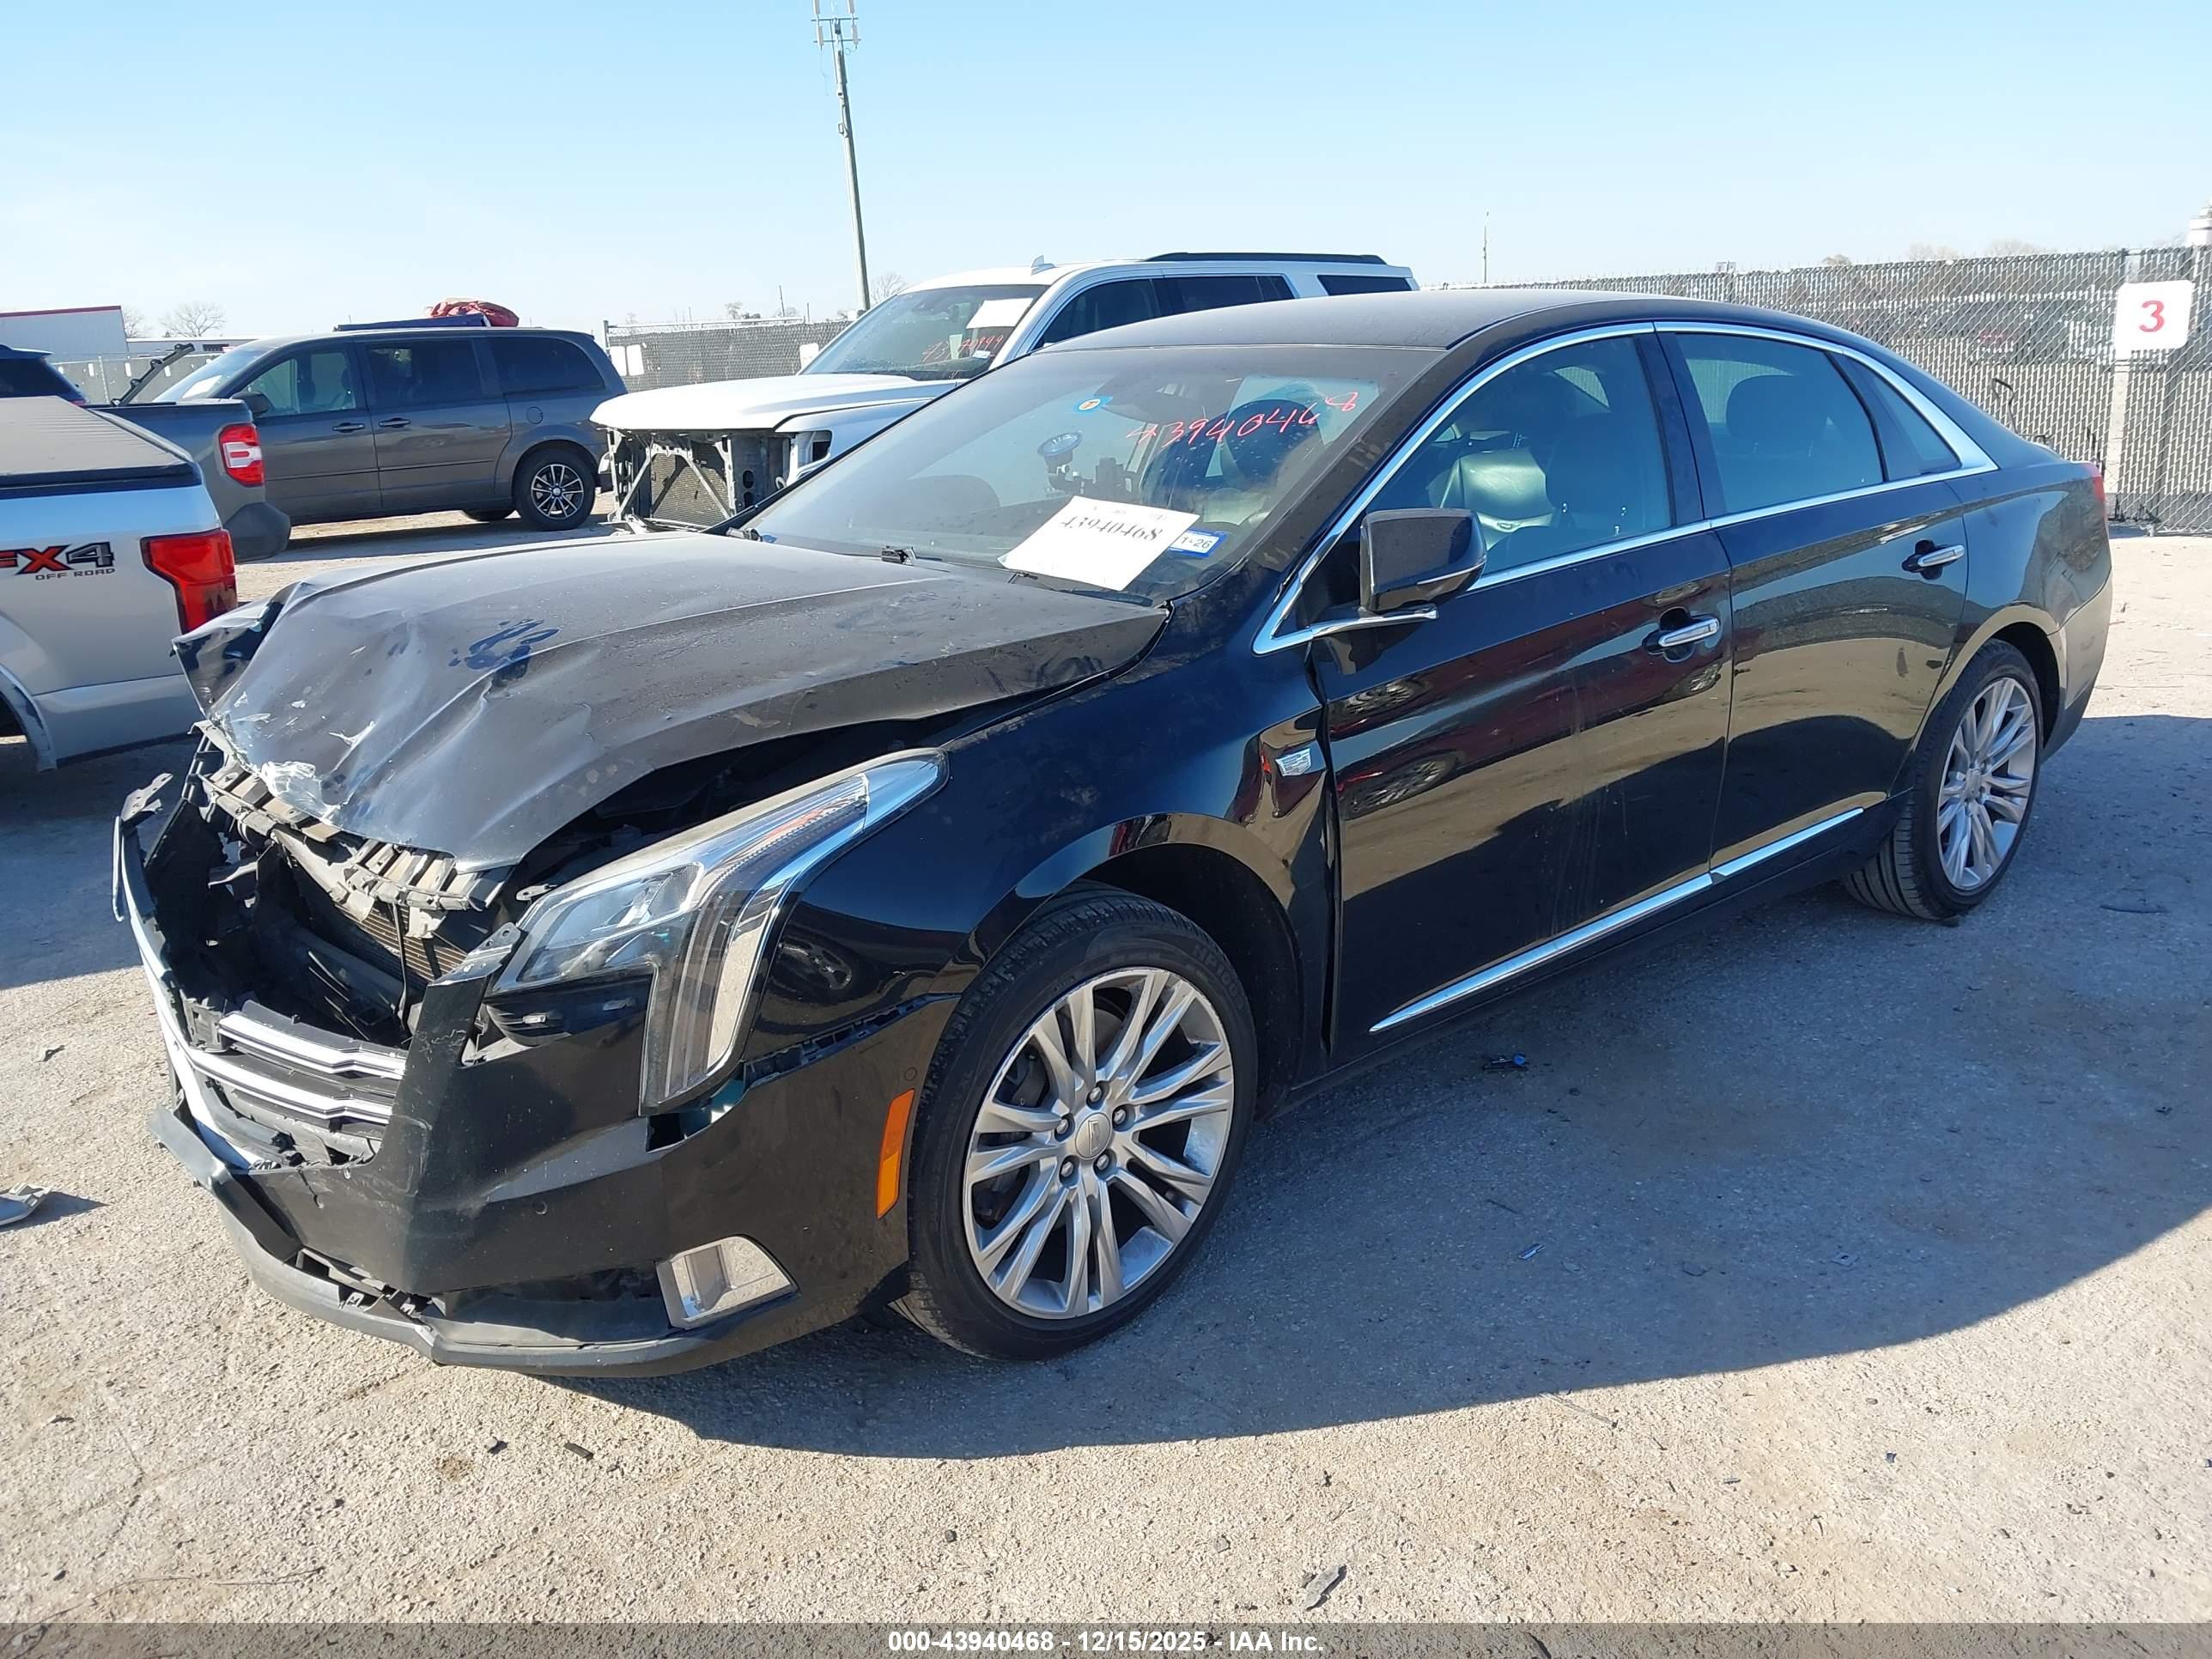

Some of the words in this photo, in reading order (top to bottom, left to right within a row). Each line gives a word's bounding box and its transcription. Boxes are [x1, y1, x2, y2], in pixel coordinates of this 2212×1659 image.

[2138, 300, 2165, 332] 3
[1126, 392, 1358, 448] 43940468
[1060, 515, 1164, 541] 43940468
[35, 572, 67, 580] OFF
[74, 568, 116, 578] ROAD
